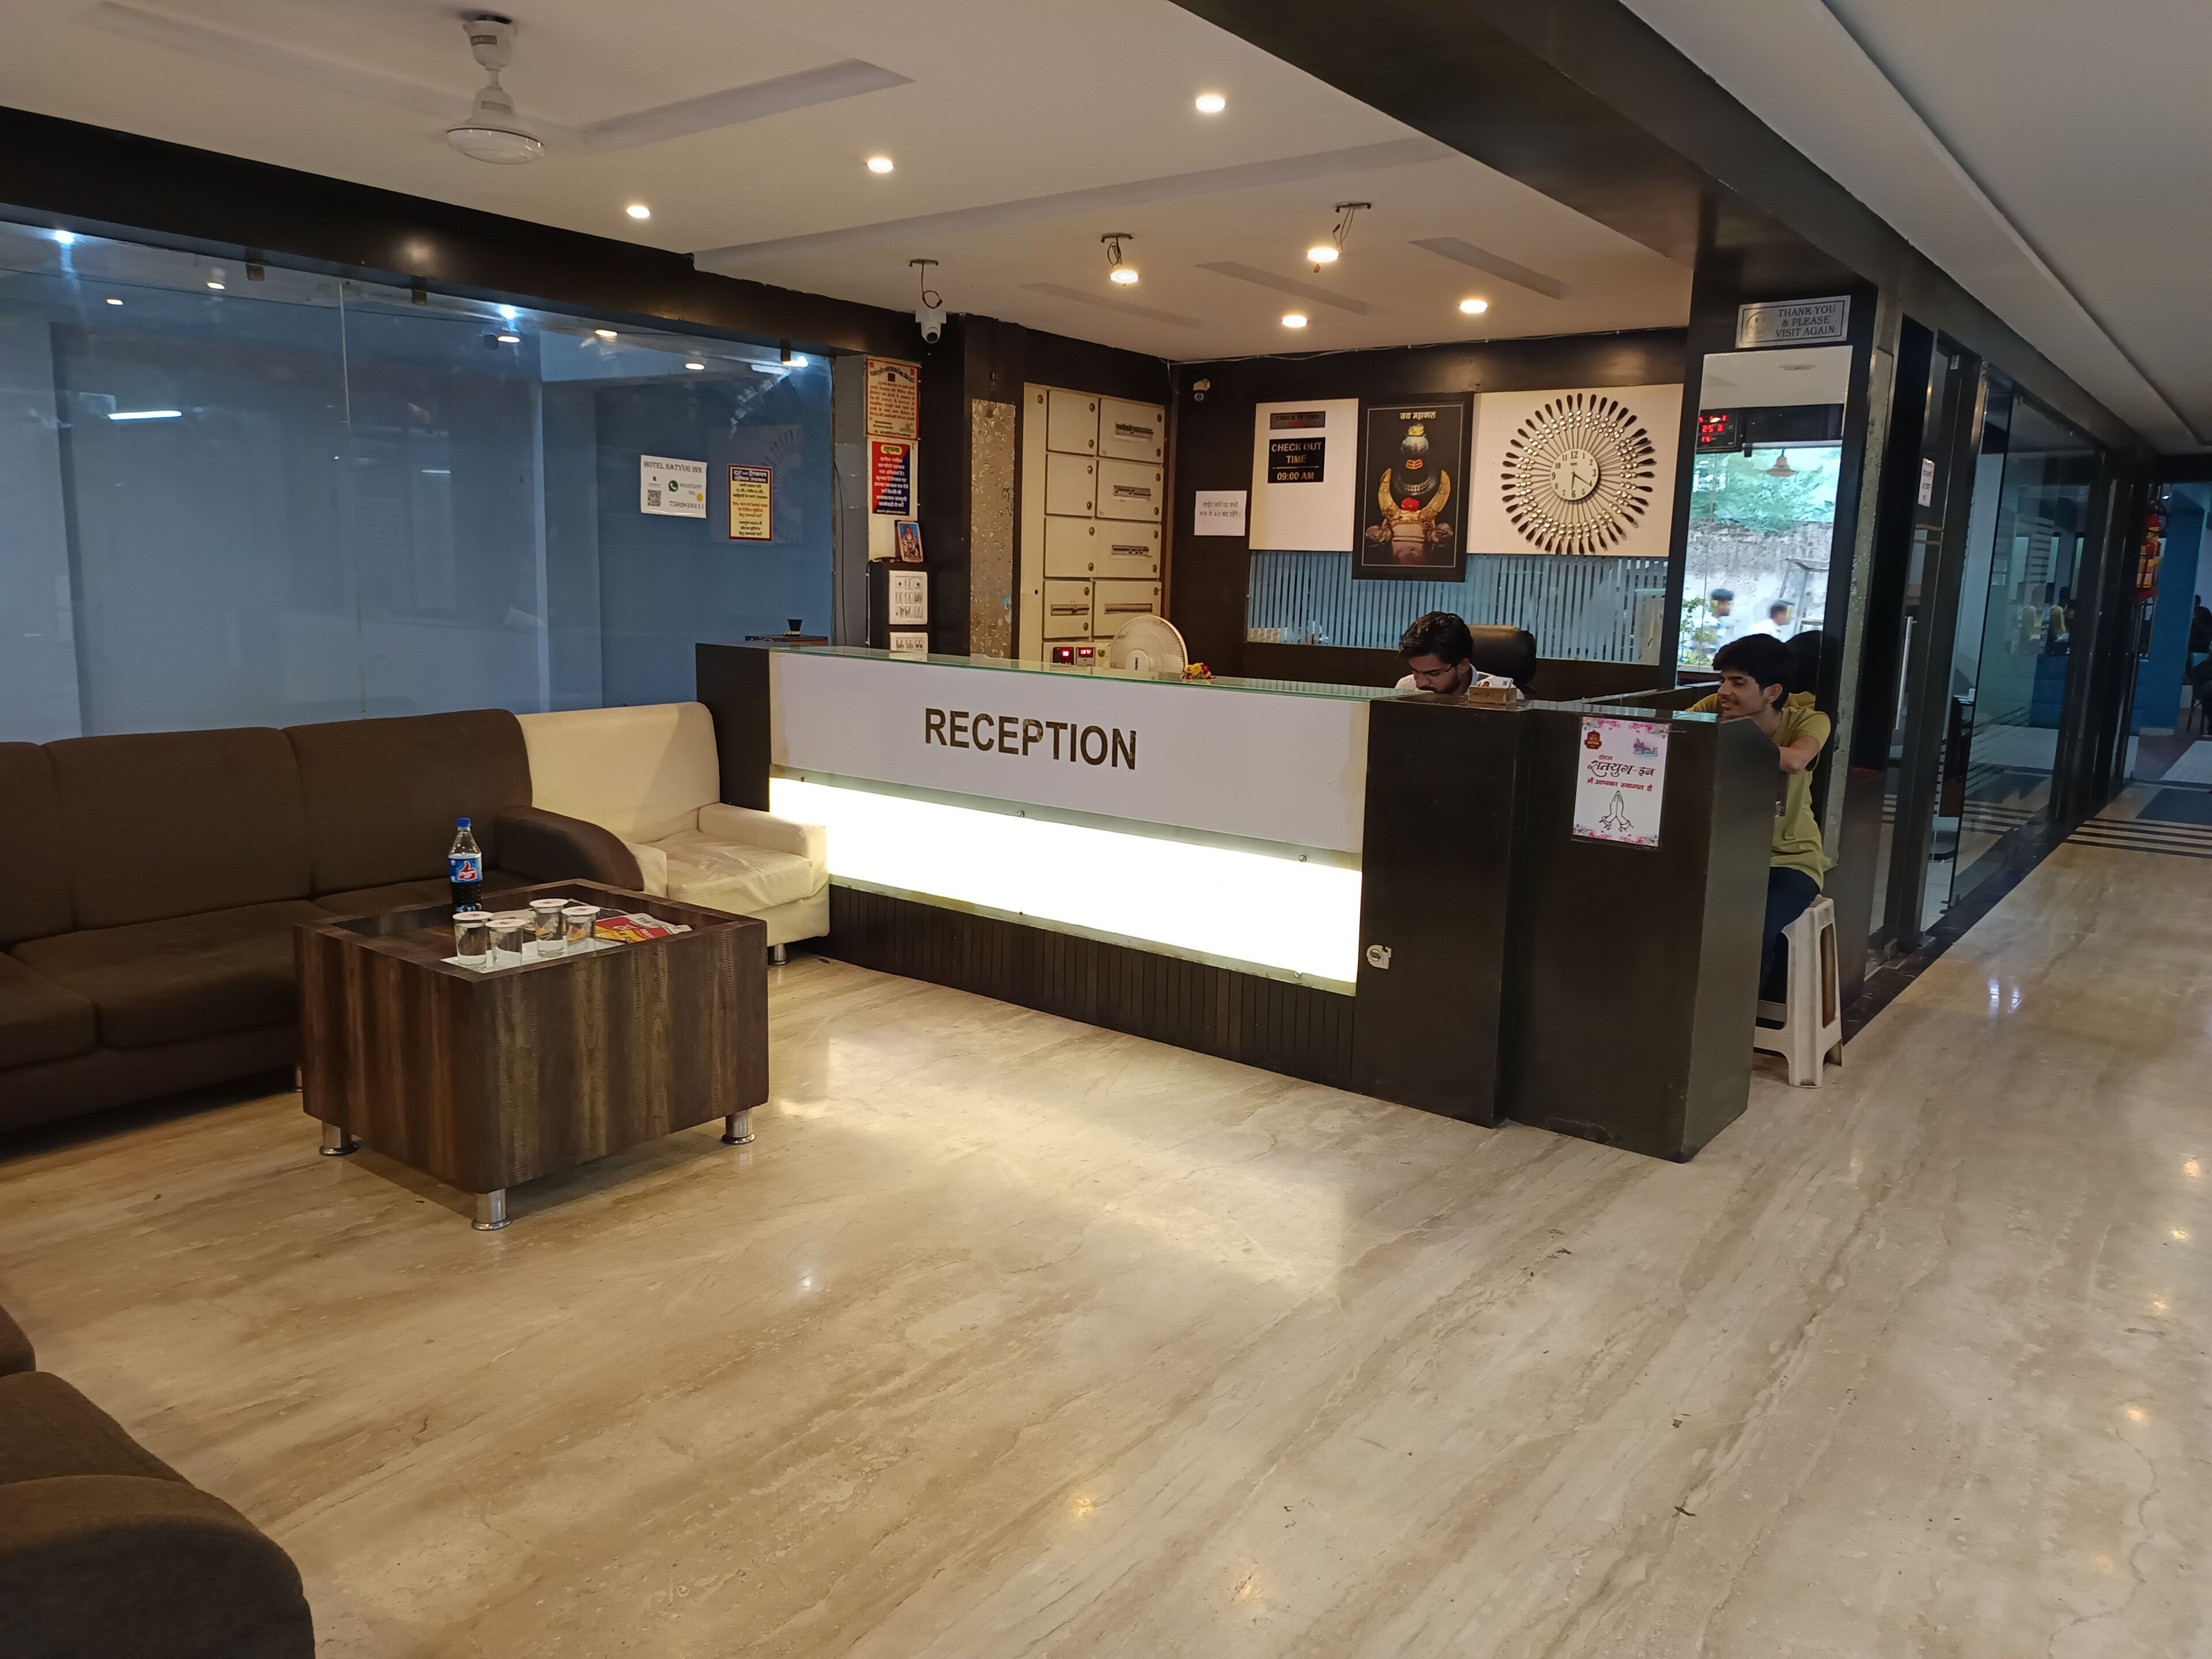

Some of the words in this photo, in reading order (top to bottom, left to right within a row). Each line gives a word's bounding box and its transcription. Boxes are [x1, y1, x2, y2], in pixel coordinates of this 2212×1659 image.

[1778, 306, 1812, 317] THANK
[1815, 305, 1836, 314] YOU
[1782, 319, 1789, 327] &
[1792, 316, 1830, 326] PLEASE
[1776, 328, 1801, 337] VISIT
[1804, 325, 1835, 336] AGAIN
[1412, 411, 1437, 420] महाकाल
[883, 445, 900, 454] सूचना
[1271, 443, 1301, 452] CHECK
[1303, 442, 1322, 450] OUT
[1286, 454, 1306, 464] TIME
[1571, 450, 1578, 459] 12
[643, 461, 665, 469] HOTEL
[665, 463, 691, 472] SATYUG
[1277, 472, 1300, 480] 09:00
[1301, 471, 1314, 480] AM
[1551, 472, 1556, 480] 9
[1592, 469, 1596, 477] 3
[1571, 490, 1576, 498] 6
[925, 707, 1137, 771] RECEPTION
[1594, 779, 1619, 787] आपका
[1620, 782, 1645, 790] स्वागत
[1646, 784, 1653, 792] है
